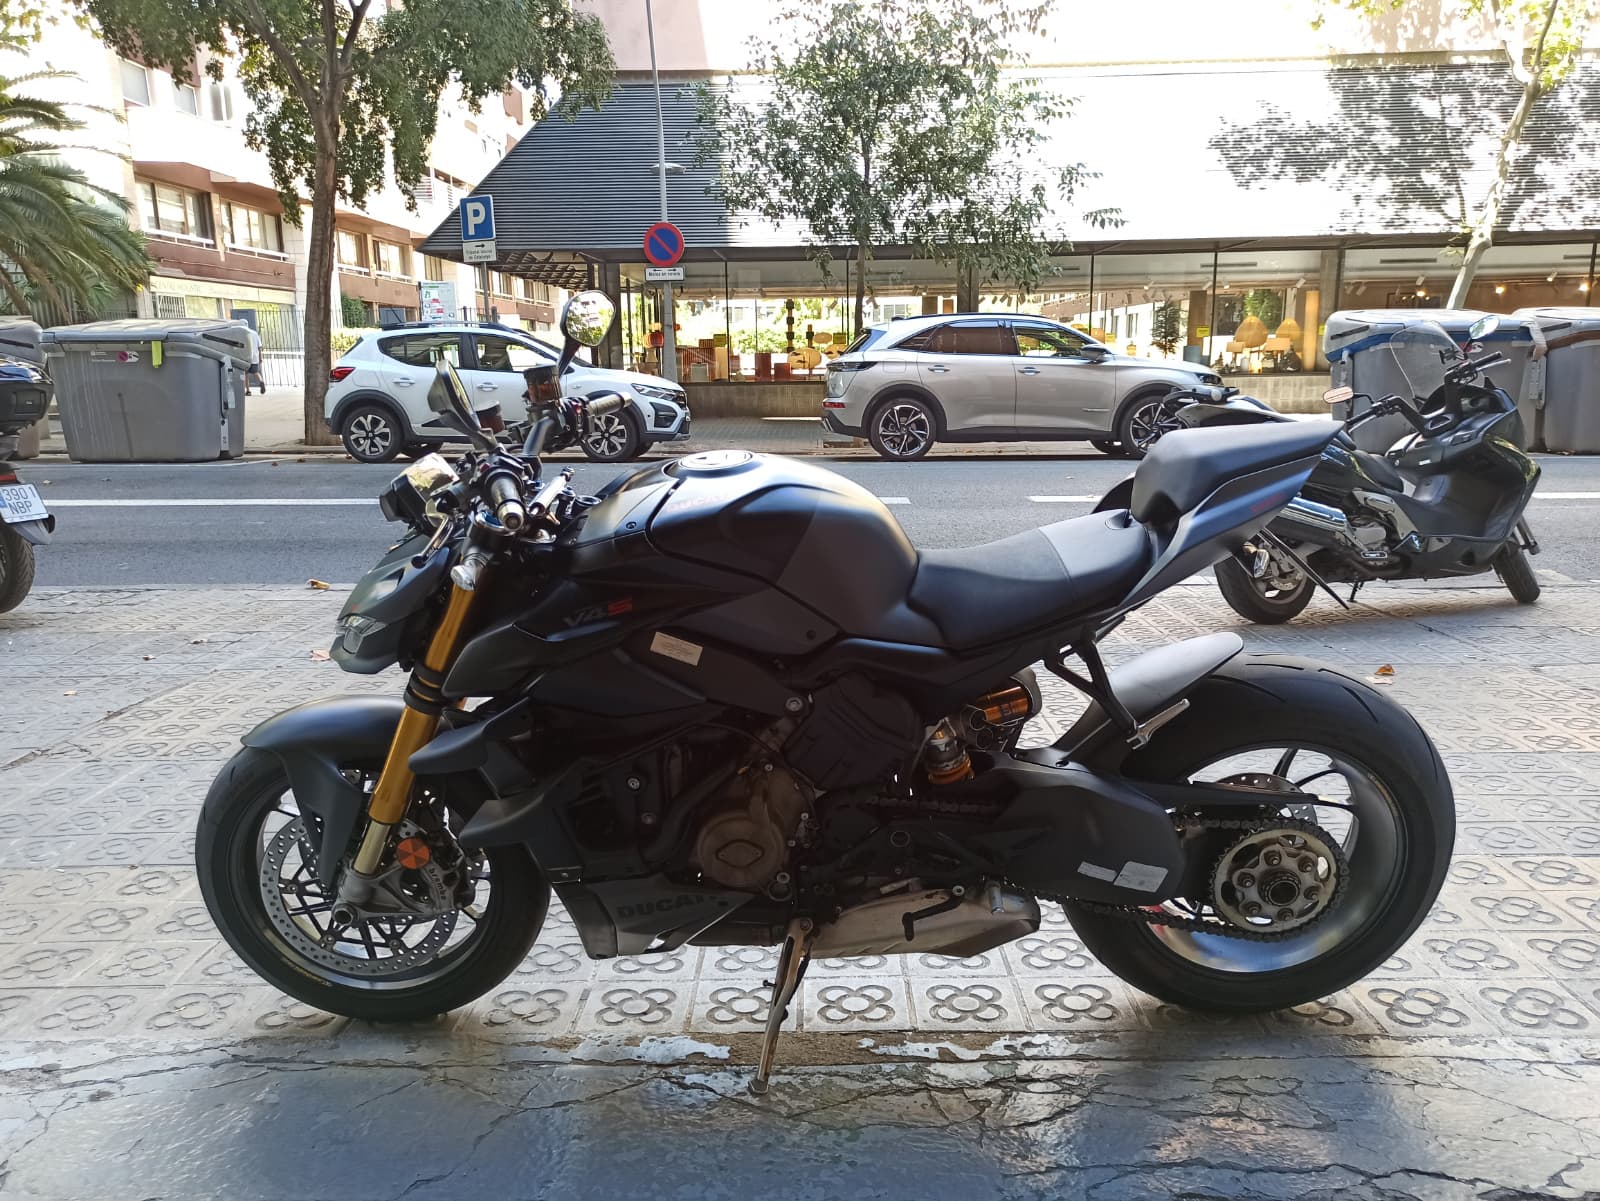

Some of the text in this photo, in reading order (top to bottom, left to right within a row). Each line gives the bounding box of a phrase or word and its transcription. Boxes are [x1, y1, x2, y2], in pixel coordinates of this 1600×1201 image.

[466, 201, 486, 236] P
[2, 486, 36, 501] 3901
[8, 500, 32, 514] NBP
